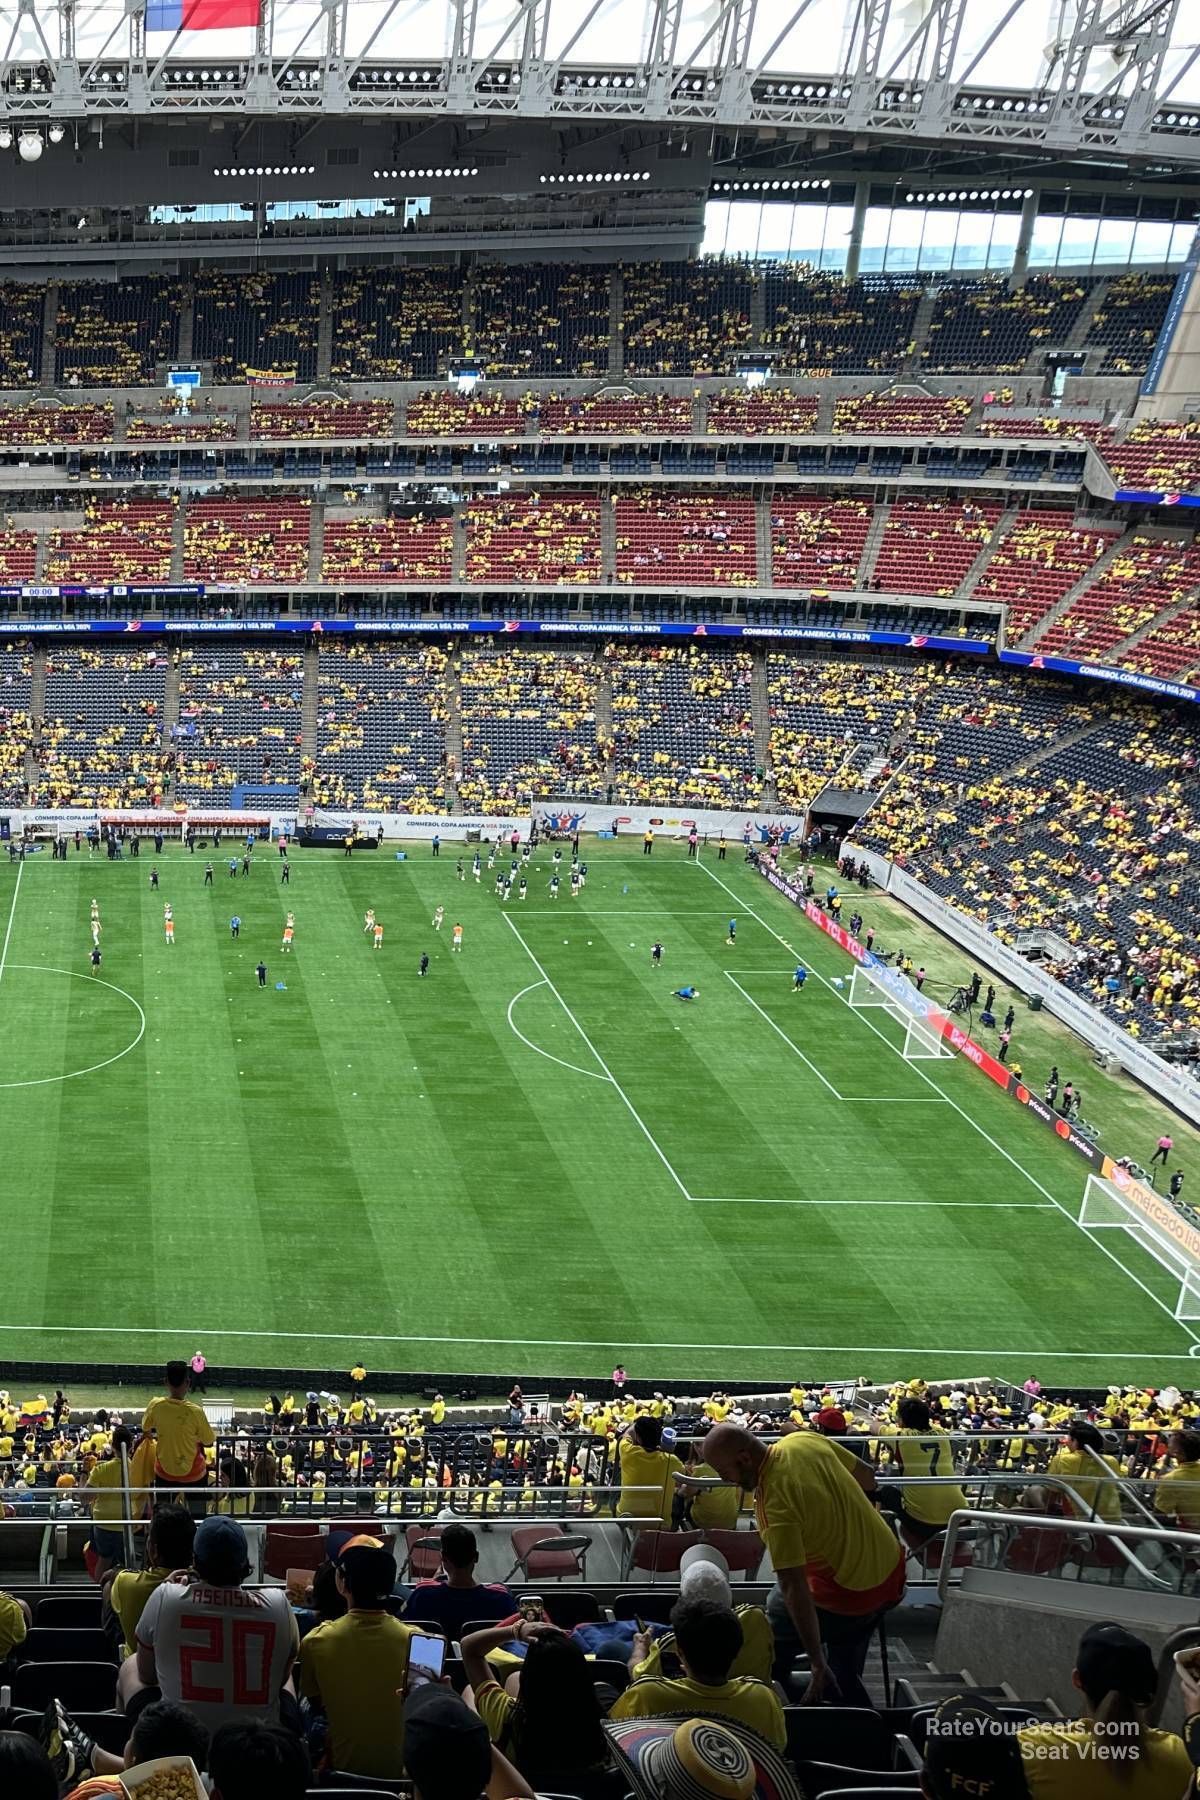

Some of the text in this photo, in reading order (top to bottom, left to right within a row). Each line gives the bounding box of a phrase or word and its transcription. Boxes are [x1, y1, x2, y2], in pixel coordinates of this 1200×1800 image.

[742, 628, 782, 637] CONMEBOL
[803, 631, 835, 639] AMERICA
[1079, 666, 1196, 699] CONMEBOL COPA AMERICA USA 2024
[806, 901, 823, 928] TCL
[827, 922, 842, 943] TCL
[847, 940, 864, 963] TCL
[1132, 1188, 1183, 1238] mercado
[920, 1443, 940, 1476] 7
[180, 1615, 276, 1704] 20
[951, 1773, 991, 1796] FCF
